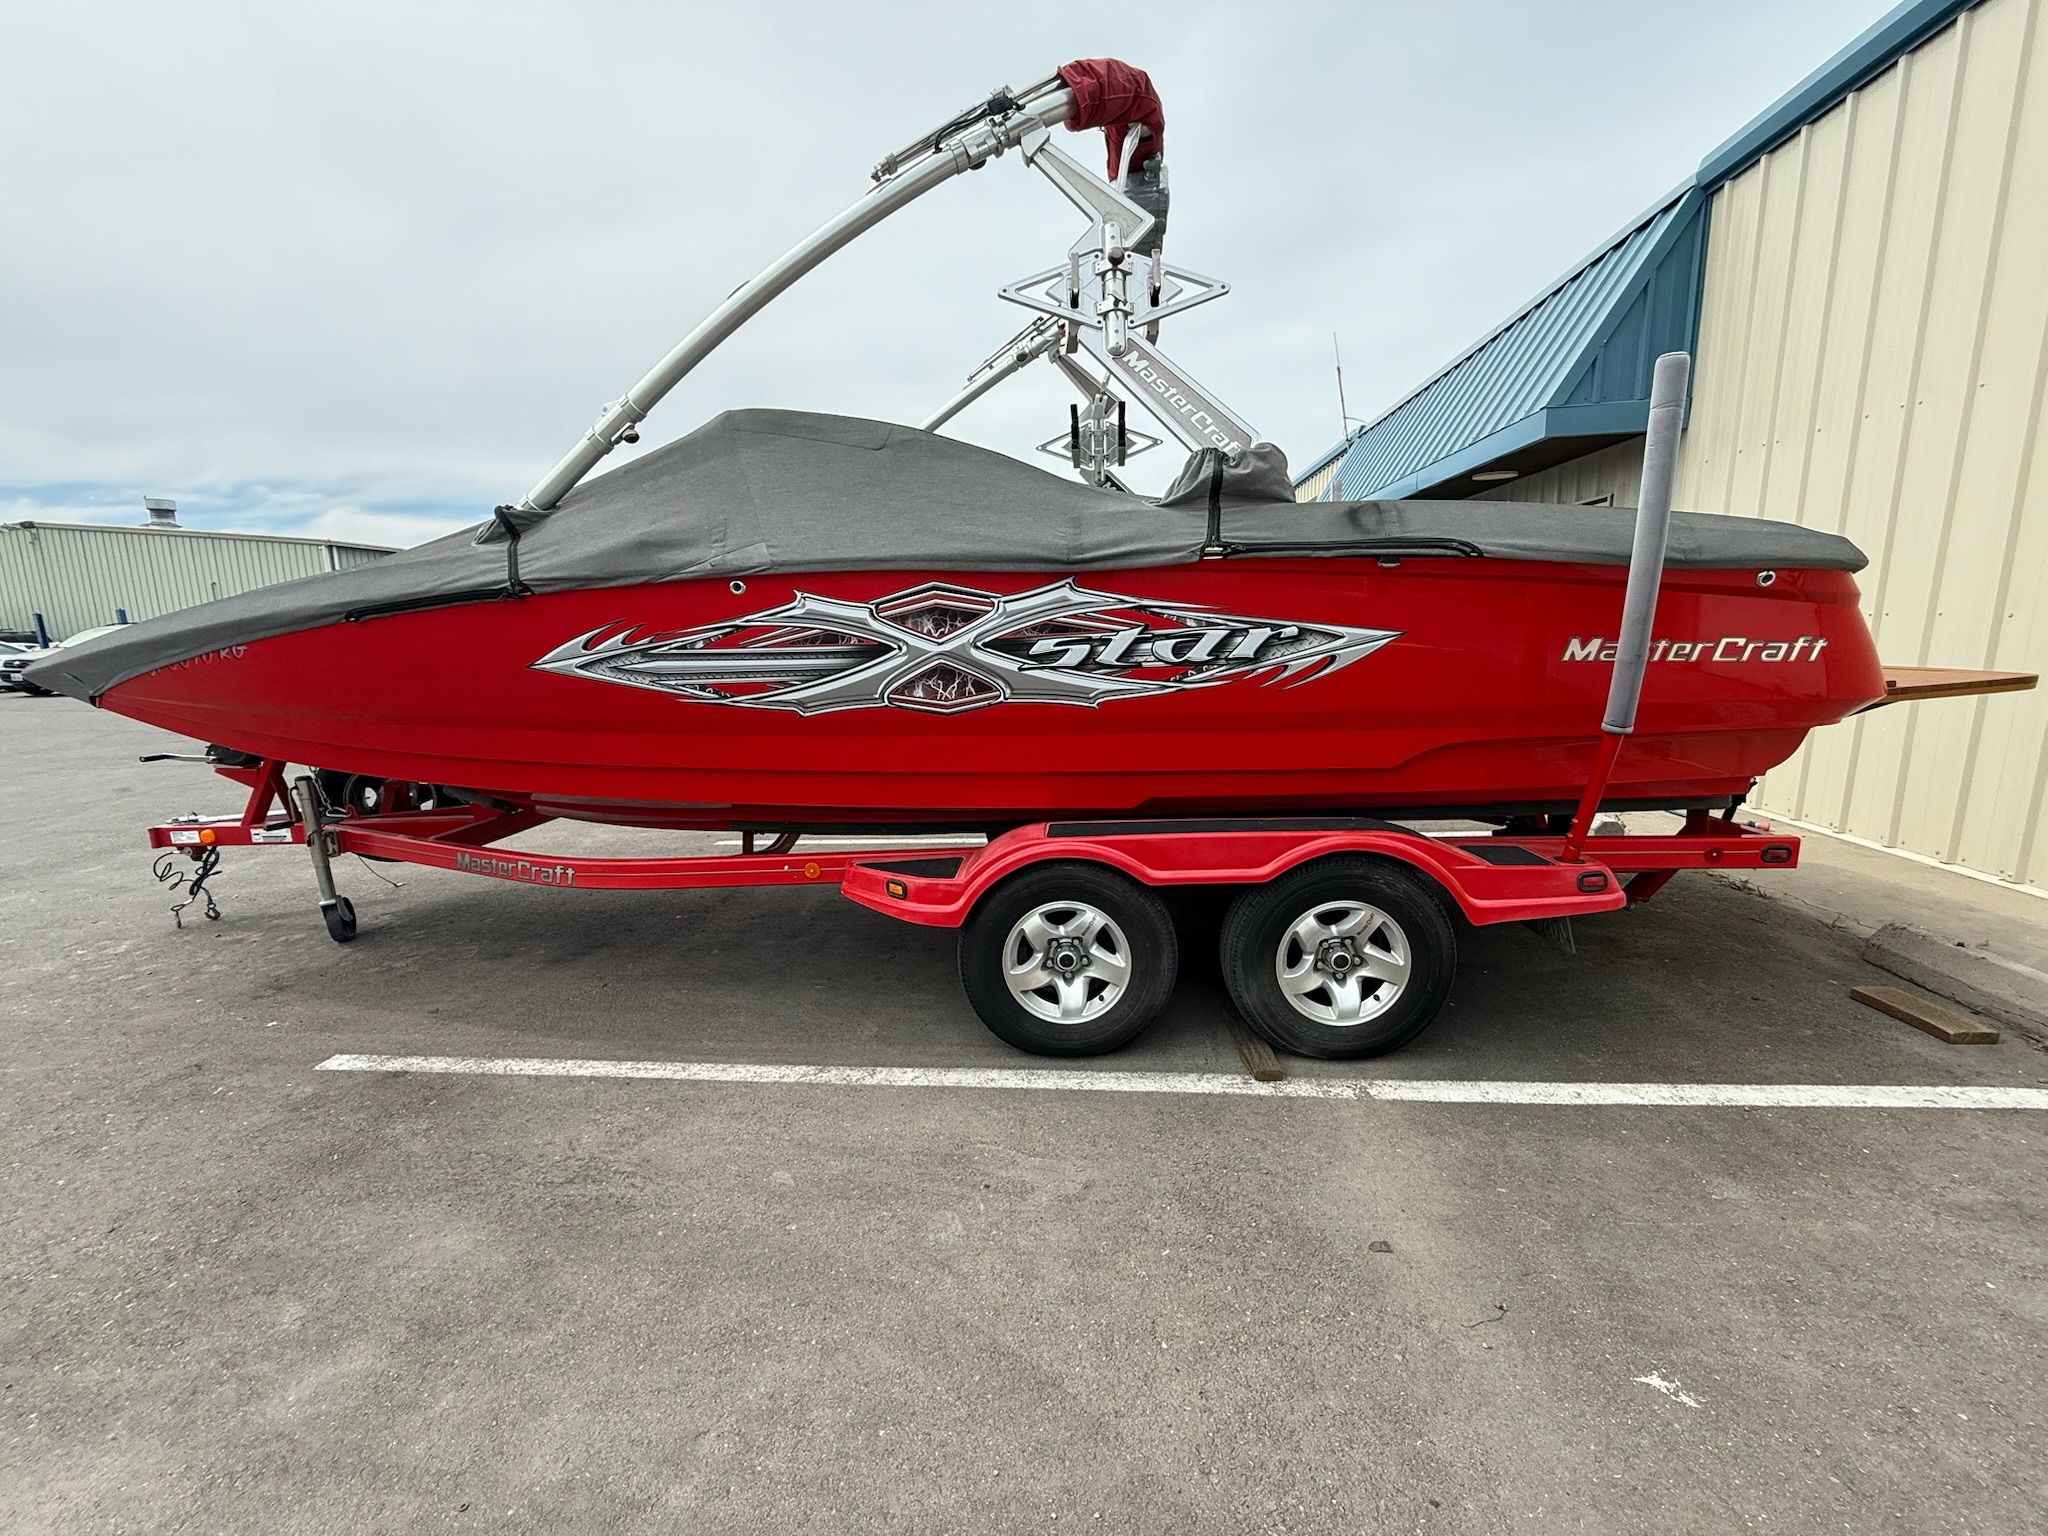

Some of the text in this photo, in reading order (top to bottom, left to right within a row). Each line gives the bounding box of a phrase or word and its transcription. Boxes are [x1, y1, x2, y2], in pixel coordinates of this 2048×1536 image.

[1122, 350, 1242, 456] MasterCraf
[1018, 623, 1300, 671] star
[1561, 636, 1830, 663] MaterCraft
[456, 852, 576, 886] MasterCraft
